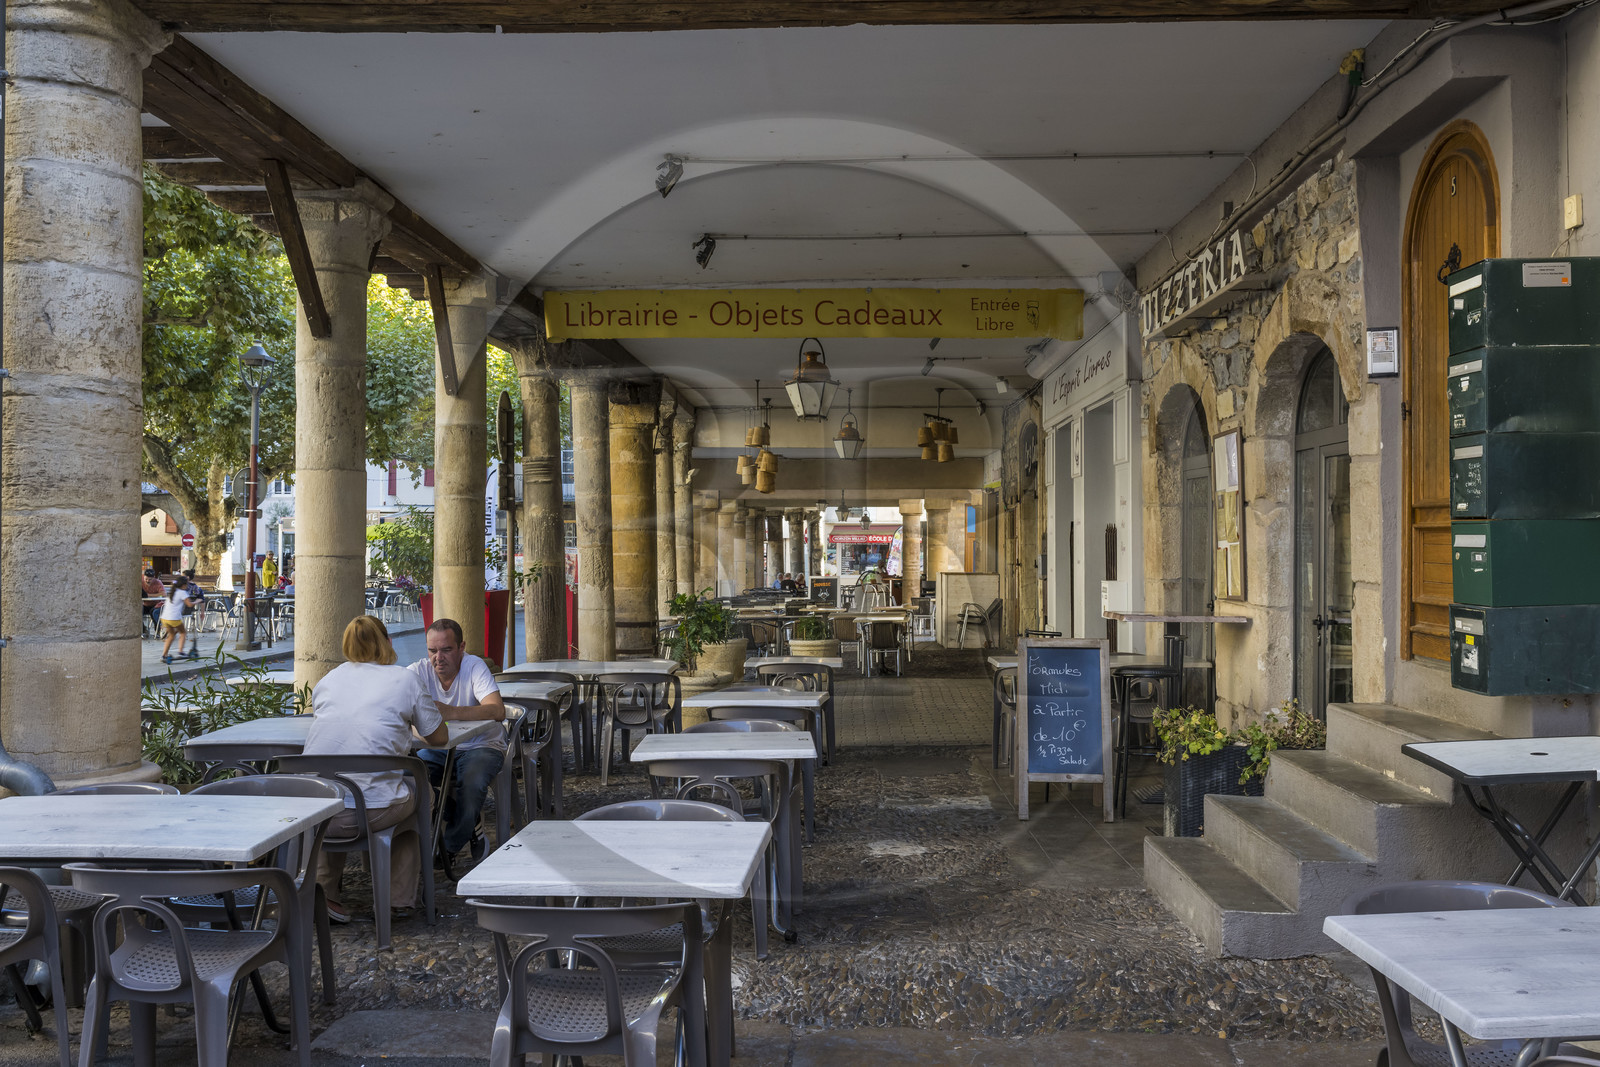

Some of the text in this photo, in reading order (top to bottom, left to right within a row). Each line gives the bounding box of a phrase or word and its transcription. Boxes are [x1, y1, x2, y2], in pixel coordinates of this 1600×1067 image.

[1451, 175, 1457, 196] 5
[970, 297, 1020, 312] Entrée
[565, 302, 678, 327] Librairie
[708, 301, 804, 332] Objets
[814, 300, 943, 327] Cadeaux
[976, 318, 1014, 331] Libre
[1053, 350, 1112, 405] L'Esprit Livres
[1028, 656, 1082, 676] Formules
[1039, 682, 1069, 696] Midi
[1046, 702, 1085, 717] Partir
[1033, 727, 1052, 743] de
[1058, 754, 1089, 766] Salade
